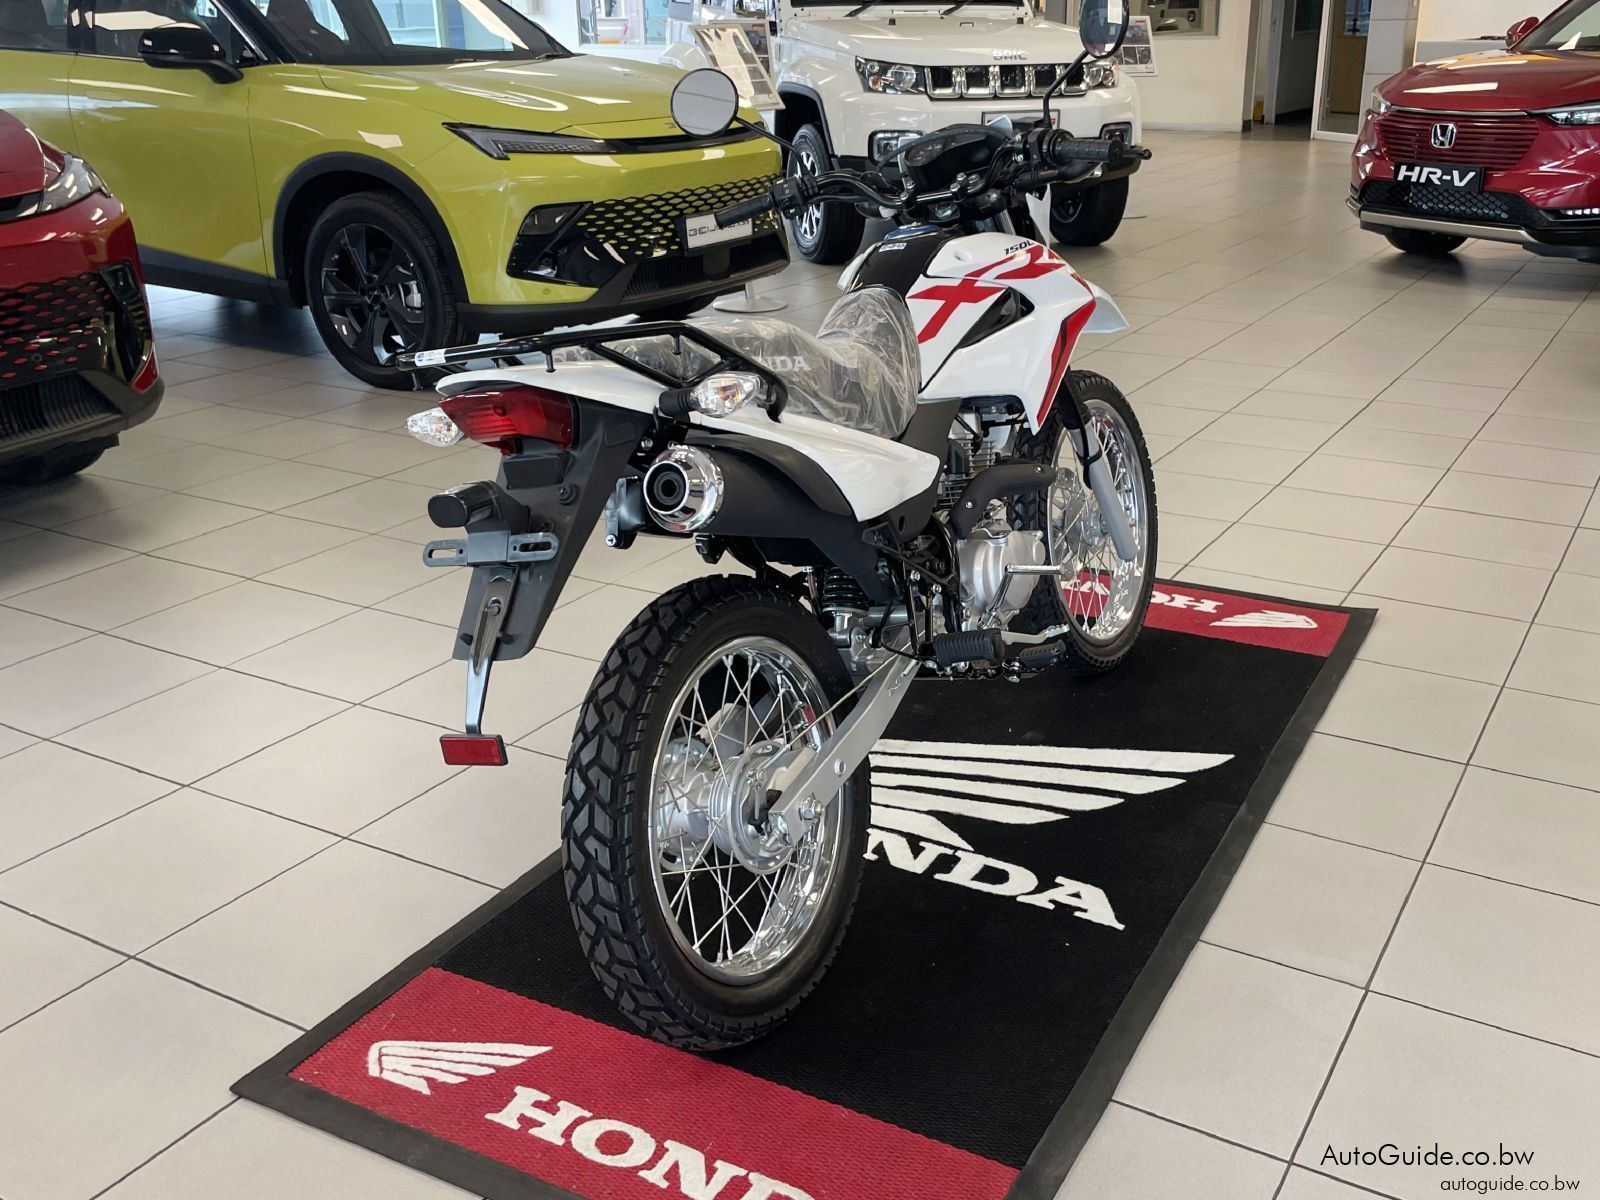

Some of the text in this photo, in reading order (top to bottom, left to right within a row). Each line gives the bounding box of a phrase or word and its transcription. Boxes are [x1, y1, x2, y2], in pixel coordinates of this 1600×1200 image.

[1397, 165, 1476, 187] HR-V
[1004, 240, 1035, 256] 150L
[862, 827, 1126, 931] NDA
